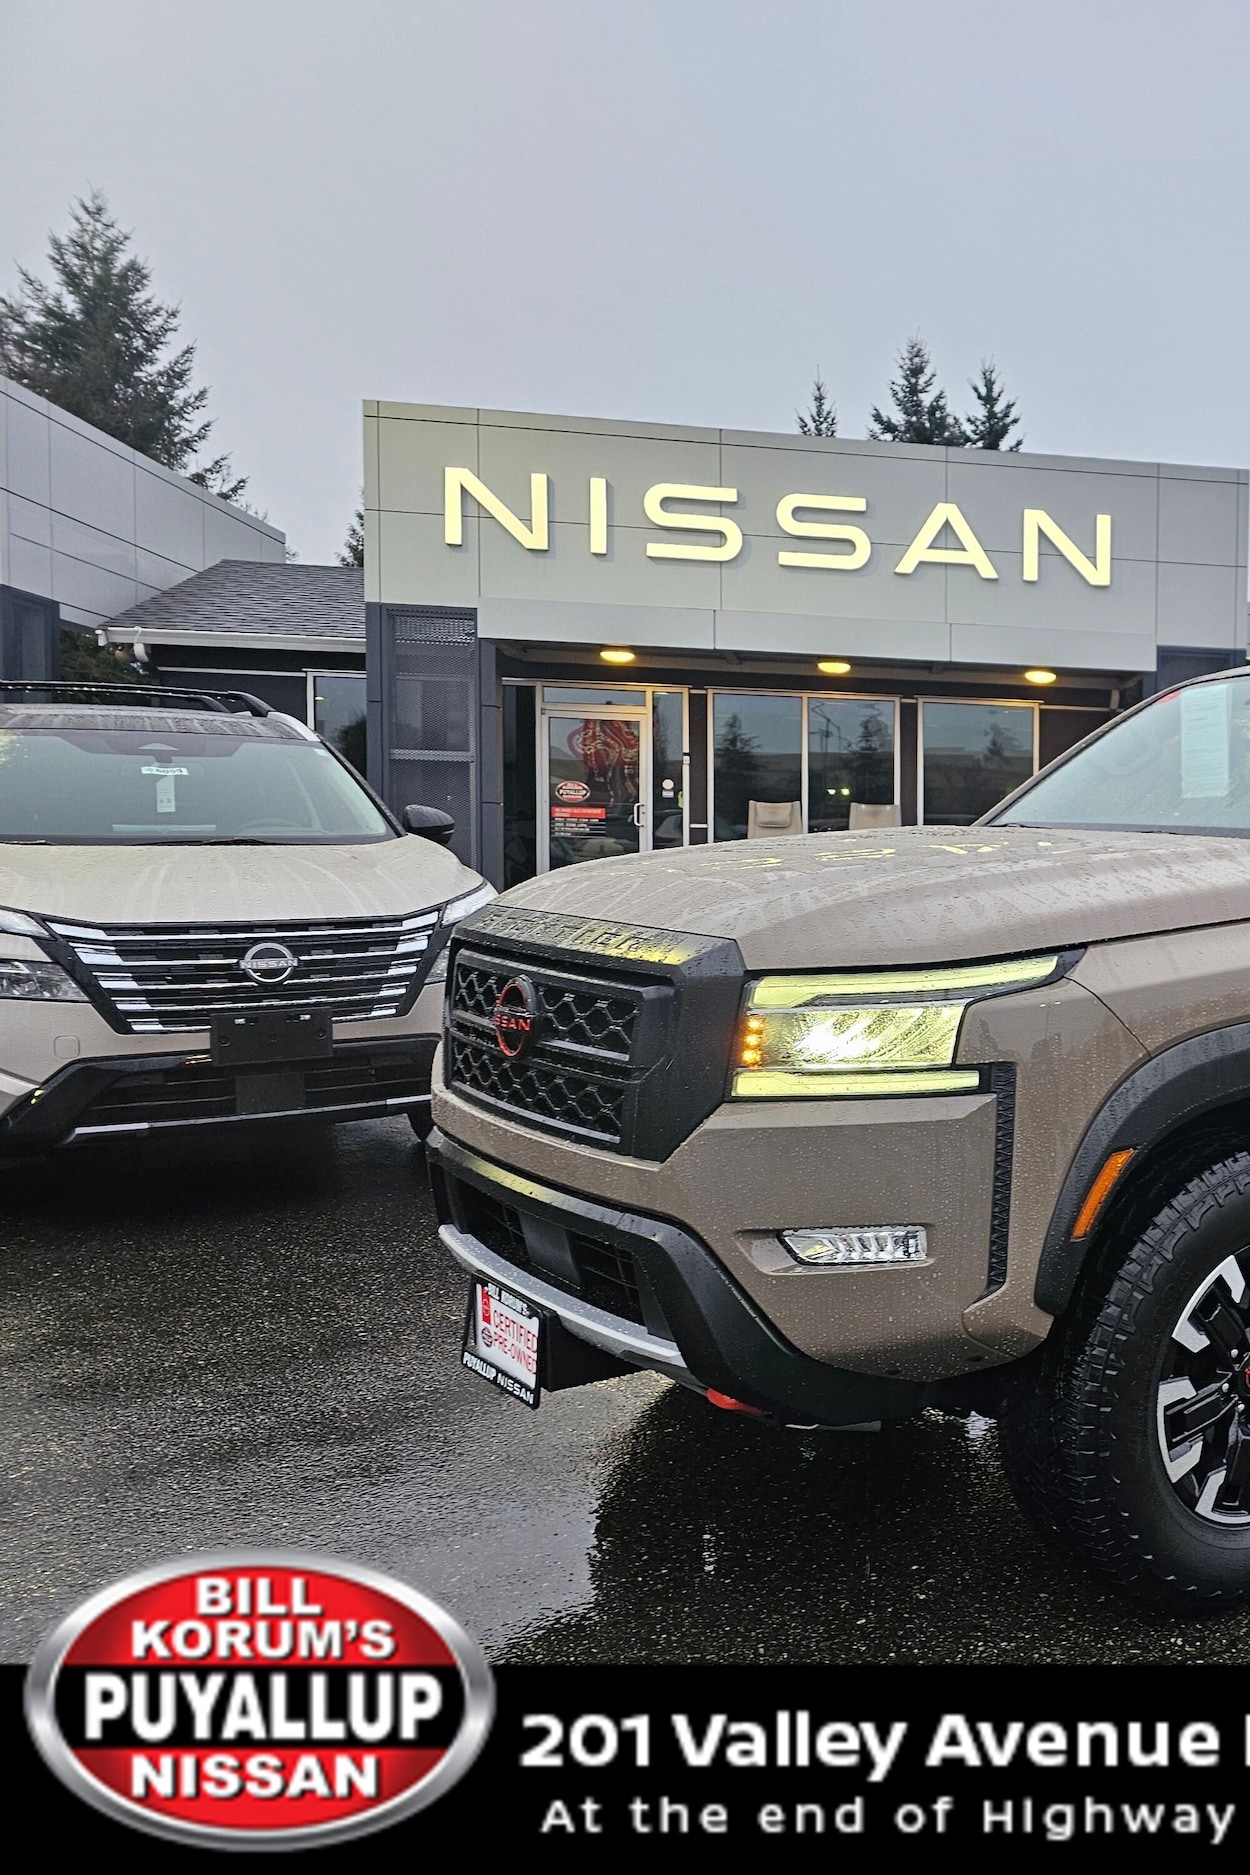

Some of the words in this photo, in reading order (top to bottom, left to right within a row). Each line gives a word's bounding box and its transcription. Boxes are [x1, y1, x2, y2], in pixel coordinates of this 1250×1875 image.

[443, 465, 1113, 588] NISSAN
[240, 959, 298, 969] NISSAN
[493, 1309, 538, 1354] CERTIFIED
[494, 1331, 538, 1375] PRE-OWNED
[497, 1372, 534, 1404] NISSAN
